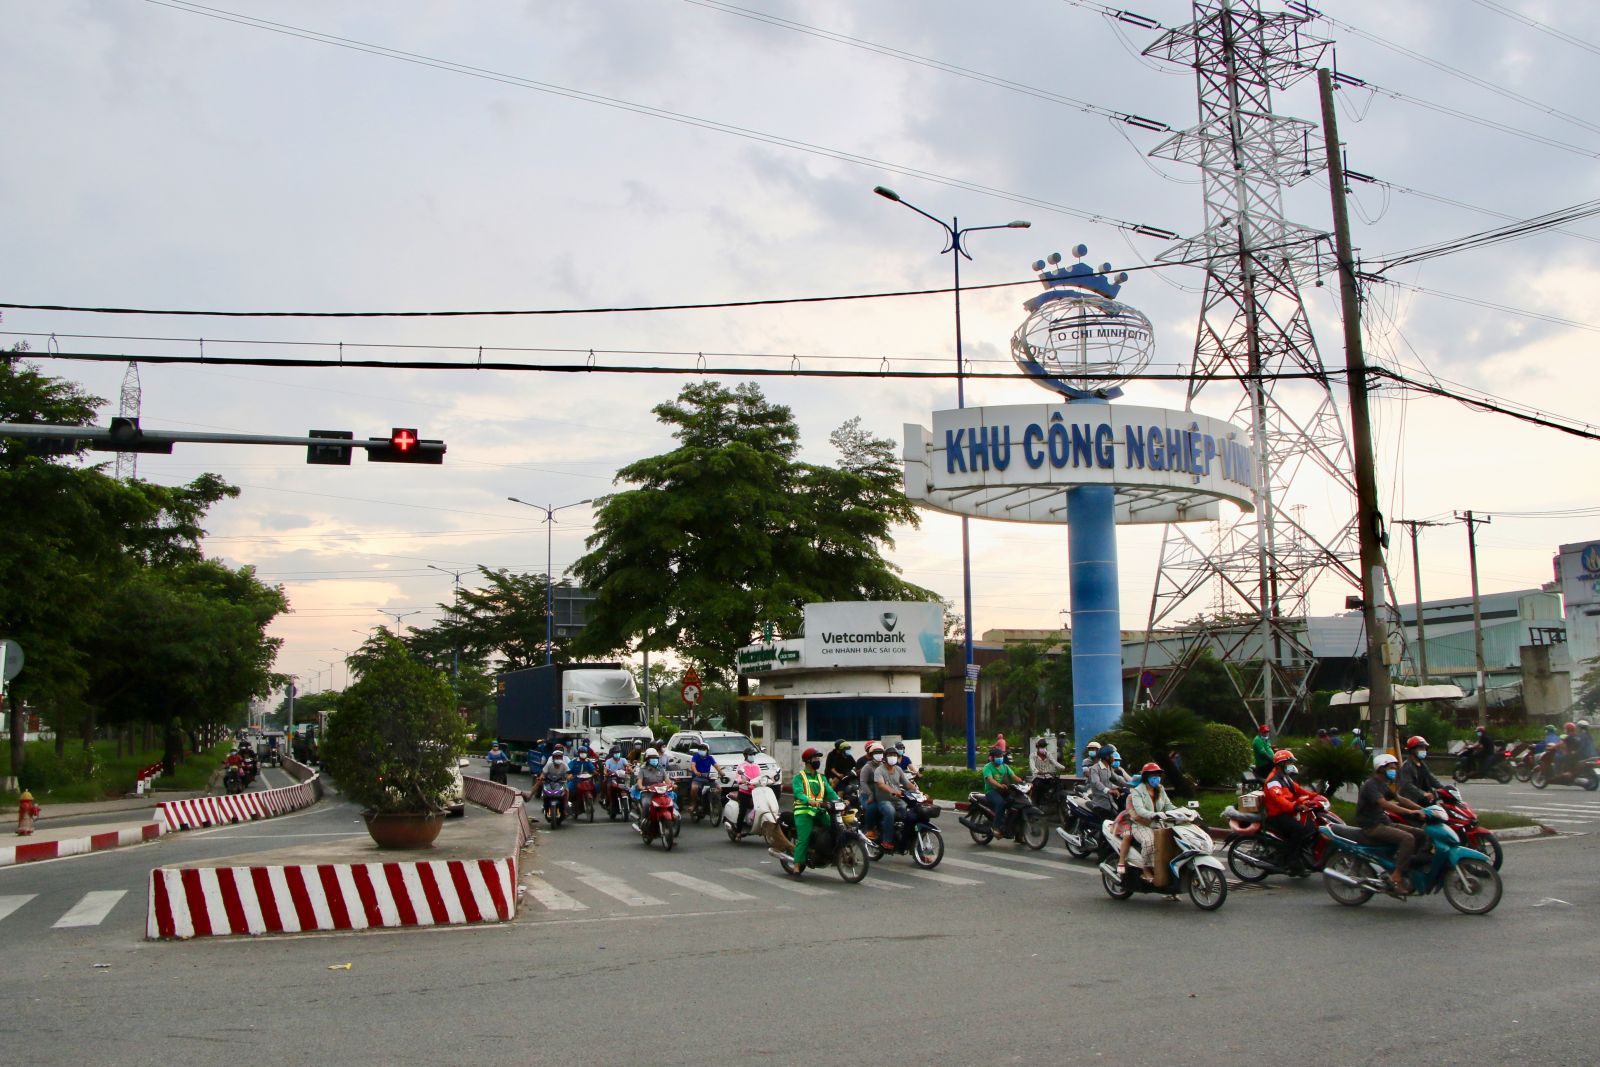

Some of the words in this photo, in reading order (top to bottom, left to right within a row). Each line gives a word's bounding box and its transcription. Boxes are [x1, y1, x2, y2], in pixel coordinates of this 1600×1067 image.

[1072, 330, 1092, 340] CHI
[1097, 329, 1126, 339] MINH
[1127, 330, 1149, 341] CITY
[946, 424, 1011, 474] KHU
[1023, 411, 1115, 470] CÔNG
[1125, 421, 1216, 485] NGHIỆP
[821, 631, 905, 644] Vietcombank
